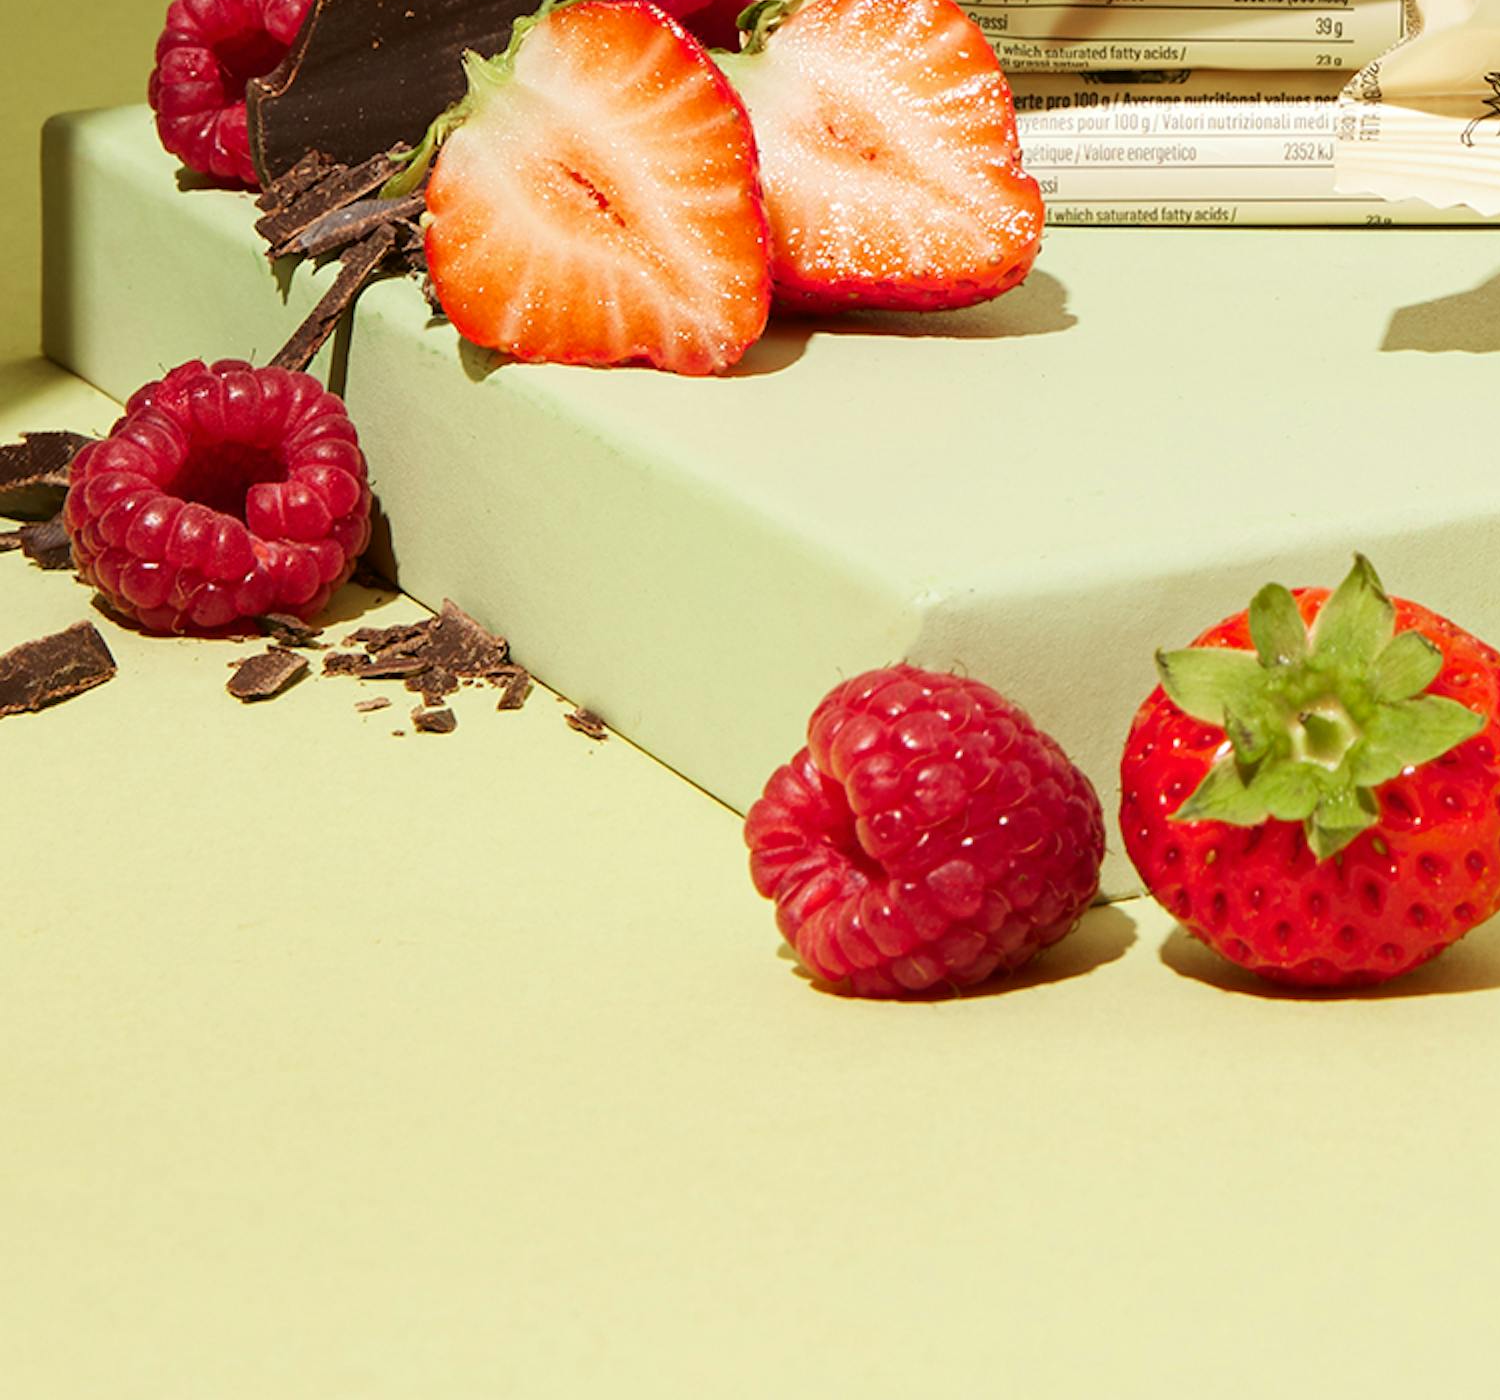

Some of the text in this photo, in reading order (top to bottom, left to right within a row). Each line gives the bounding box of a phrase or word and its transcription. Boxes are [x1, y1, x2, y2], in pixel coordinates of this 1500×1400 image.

[1084, 142, 1334, 164] Valore energetico 2352 kJ
